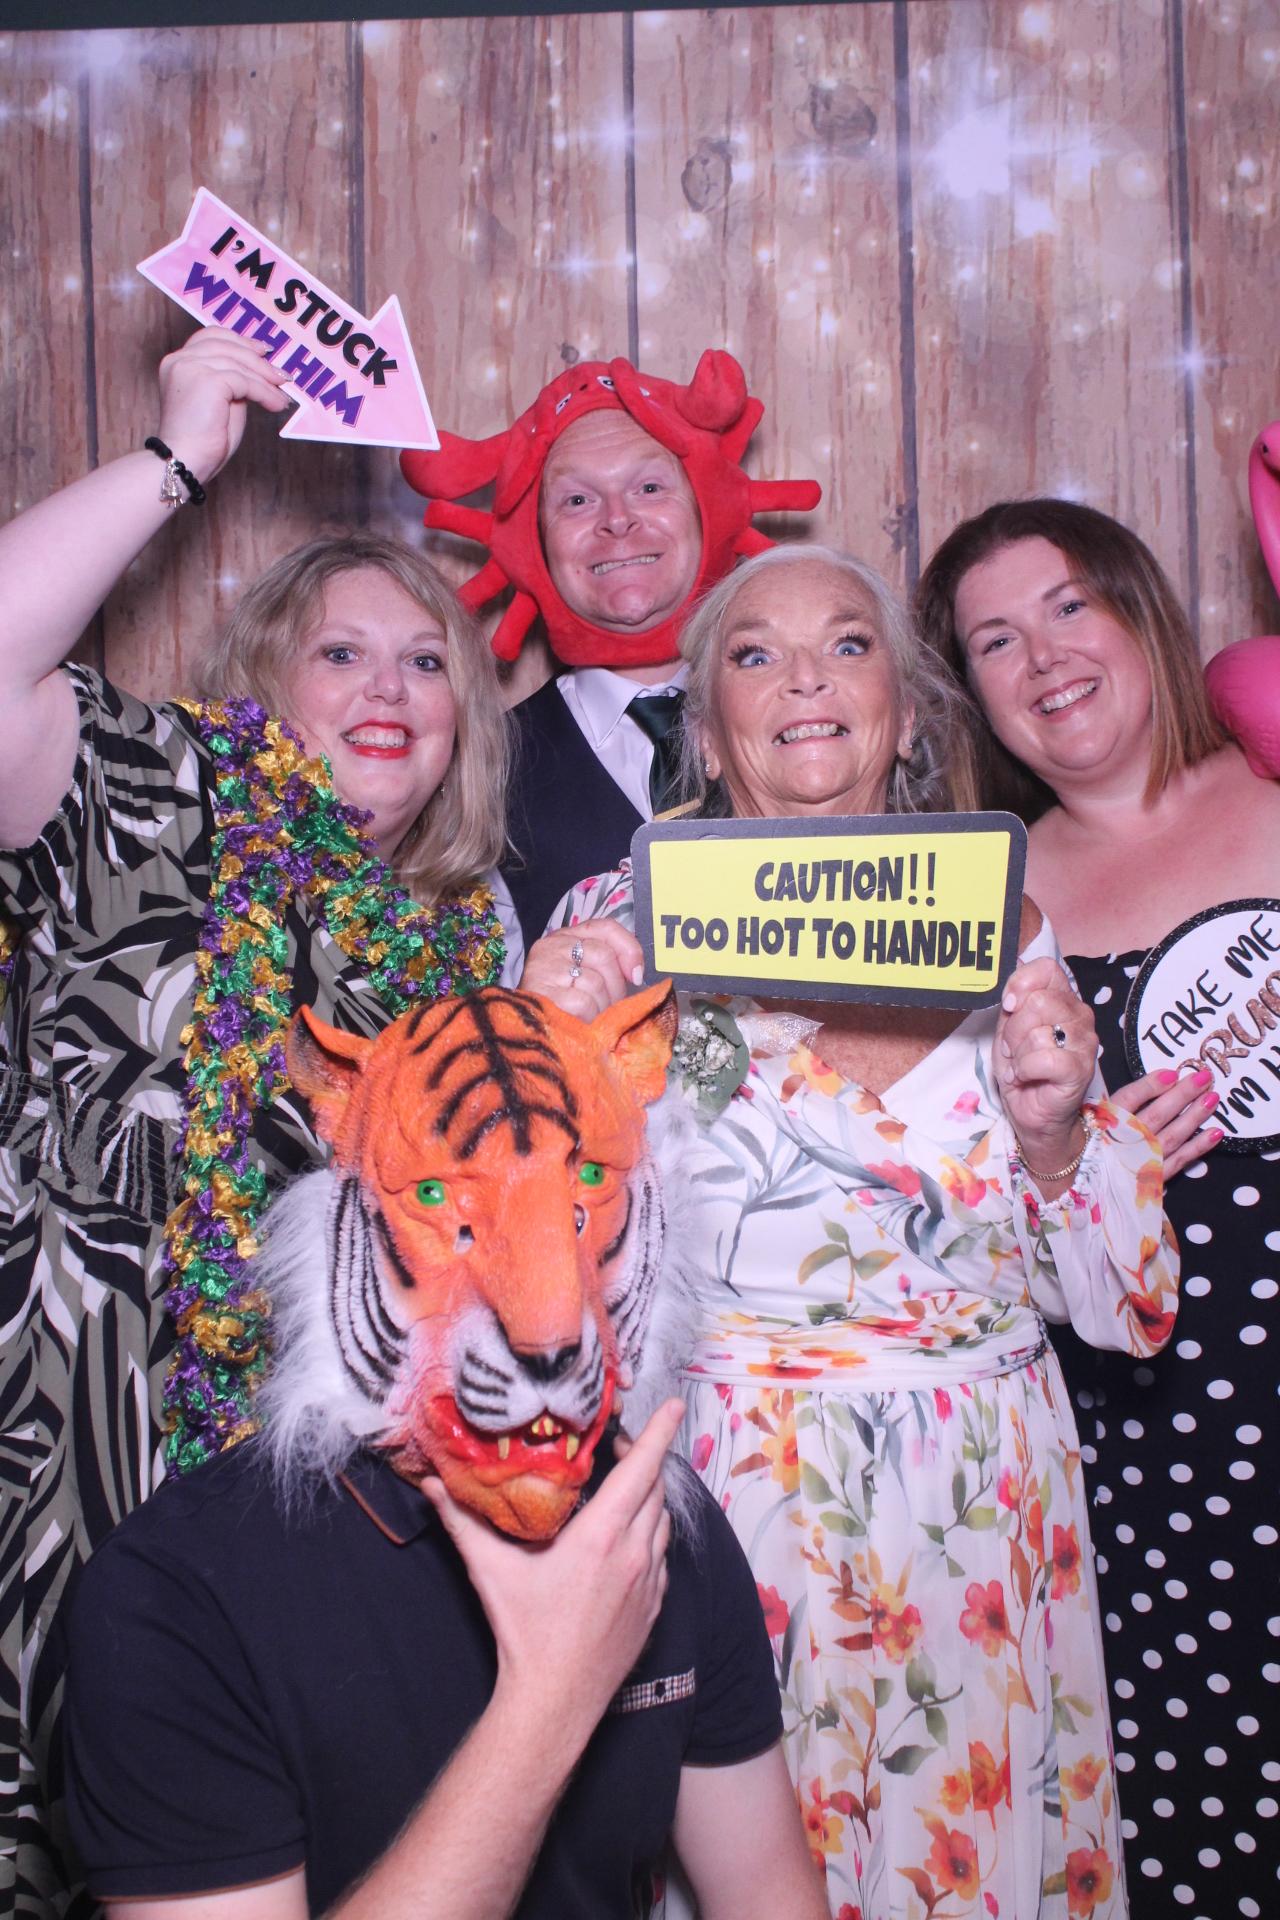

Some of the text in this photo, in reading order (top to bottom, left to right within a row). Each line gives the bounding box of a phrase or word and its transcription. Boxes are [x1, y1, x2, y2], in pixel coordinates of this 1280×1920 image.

[183, 261, 366, 428] WITH HIM
[209, 226, 399, 388] I'M STUCK
[660, 914, 996, 972] TOO HOT TO HANDLE
[754, 851, 937, 908] CAUTION!!
[1141, 913, 1280, 1058] TAKE ME
